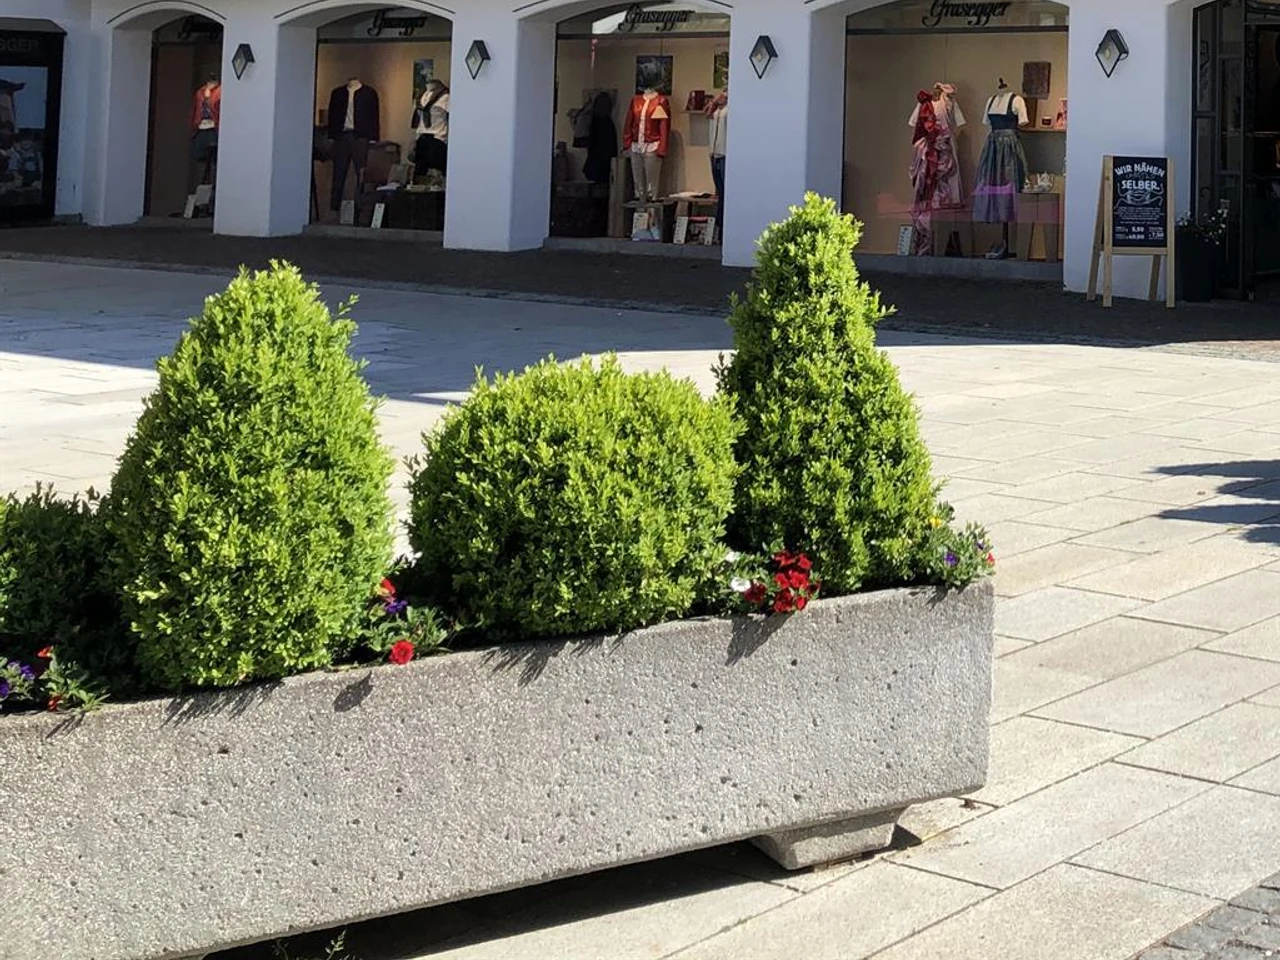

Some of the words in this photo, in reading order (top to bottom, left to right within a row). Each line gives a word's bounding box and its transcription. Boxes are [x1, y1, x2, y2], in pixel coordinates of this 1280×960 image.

[618, 3, 695, 31] Grasegger
[1114, 164, 1132, 176] WIR
[1134, 162, 1165, 177] NÄHEN
[1121, 180, 1160, 190] SELBER.
